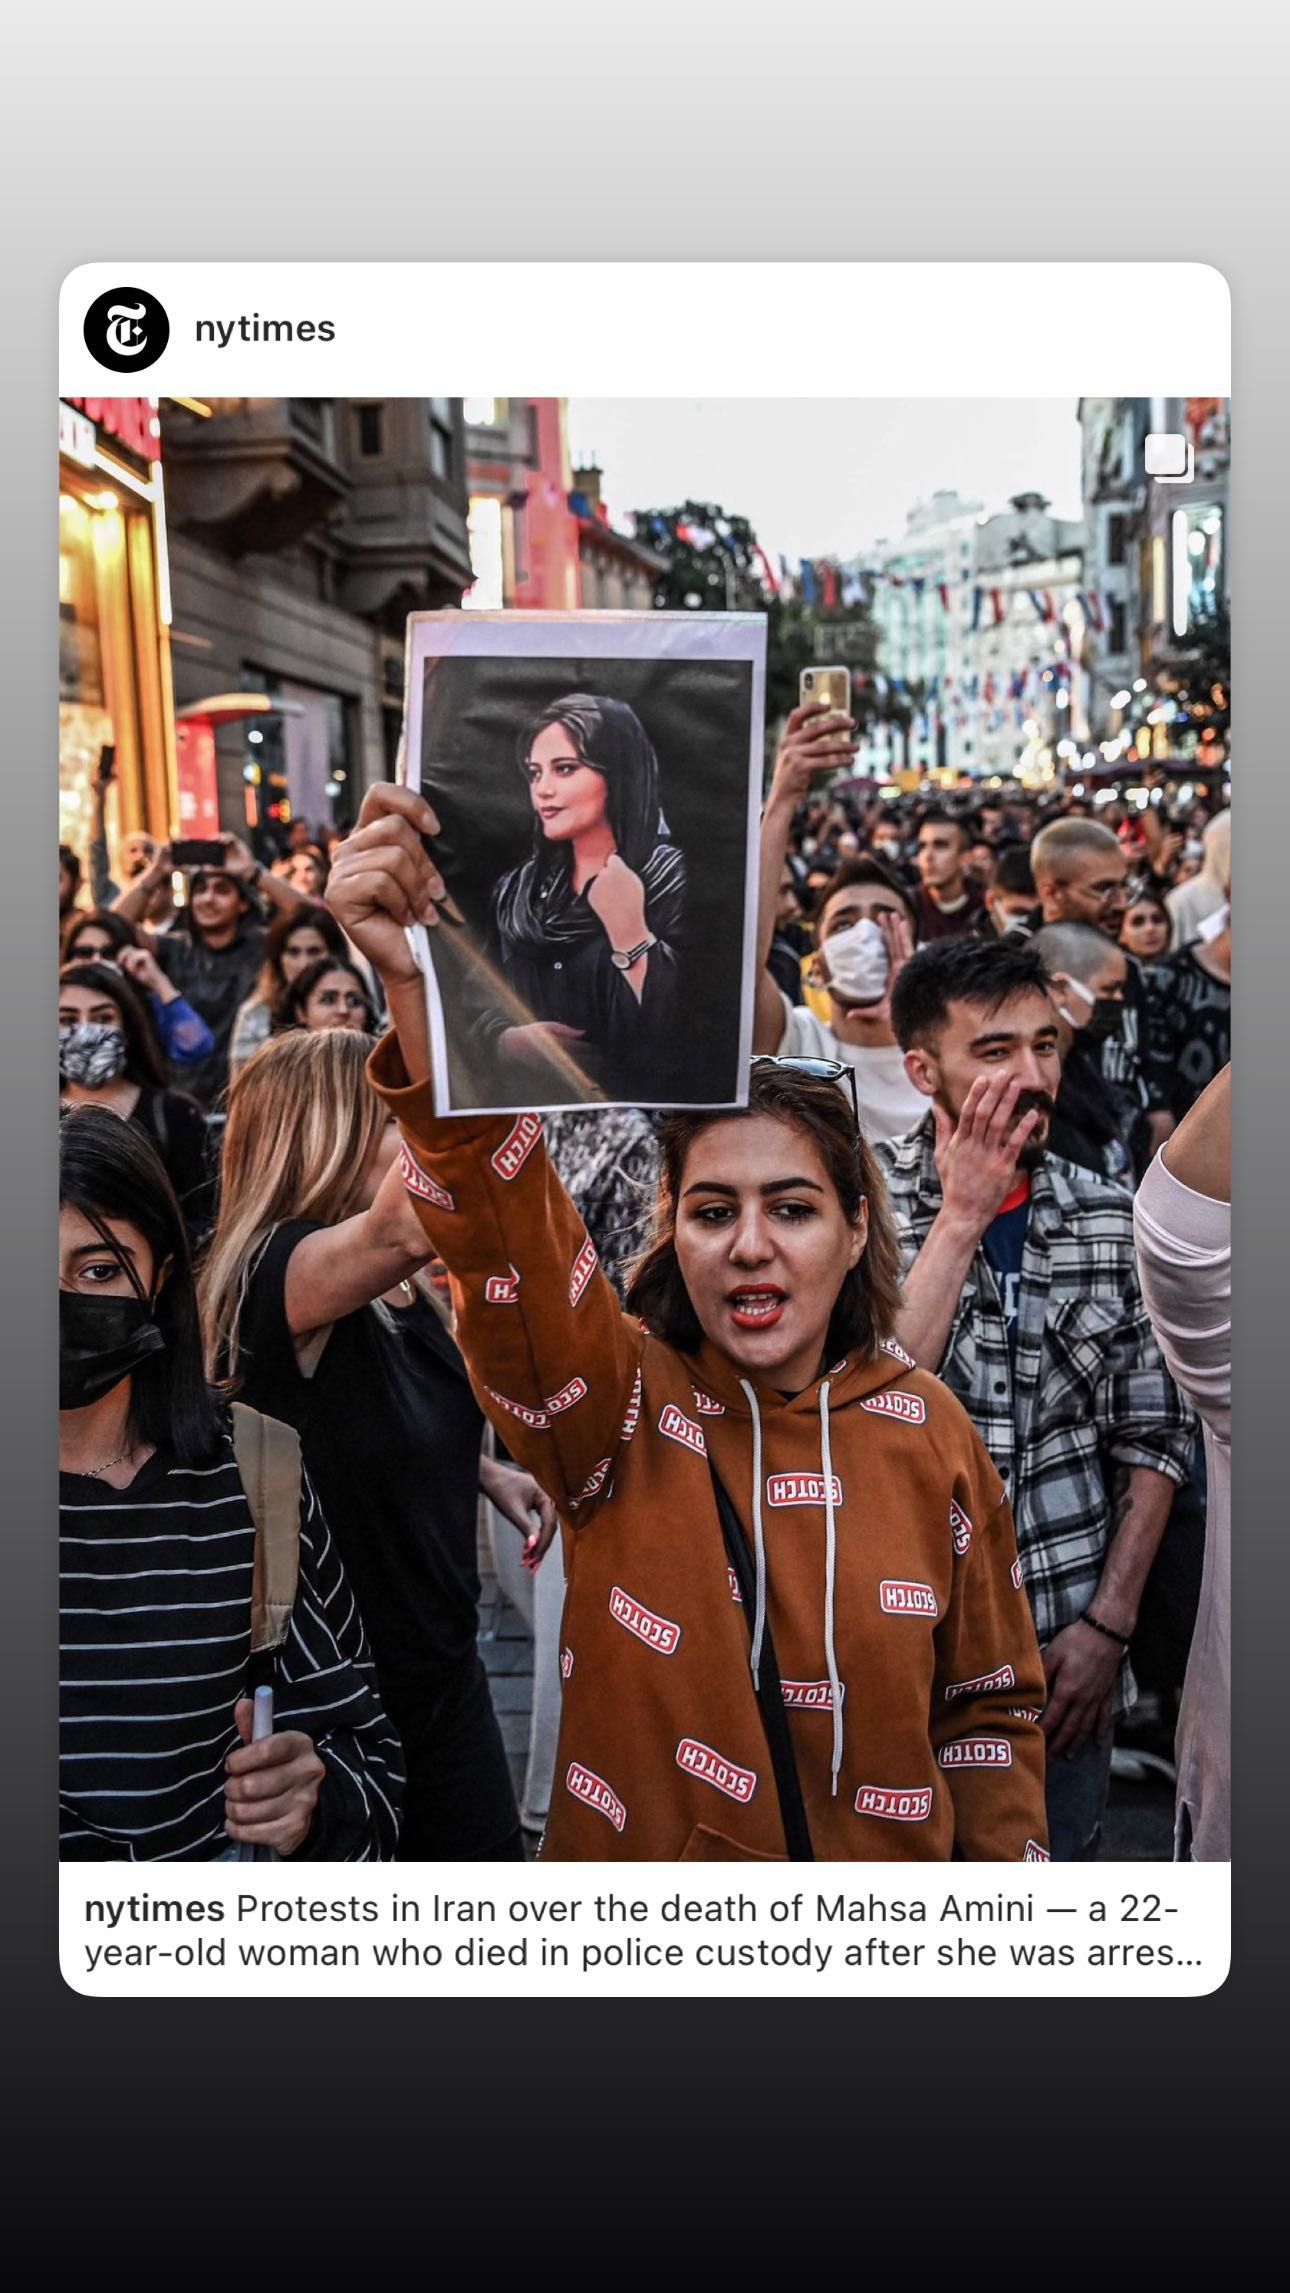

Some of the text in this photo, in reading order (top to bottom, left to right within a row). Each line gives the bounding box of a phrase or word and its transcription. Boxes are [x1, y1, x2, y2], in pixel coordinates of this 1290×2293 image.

[949, 1504, 970, 1549] SCO
[612, 1593, 674, 1648] SCOTCH
[885, 1586, 937, 1611] SCOTCH
[680, 1745, 750, 1797] SCOTCH
[942, 1743, 1008, 1763] SCOTCH
[569, 1768, 624, 1824] SCOTCH
[860, 1790, 930, 1815] SCOTCH
